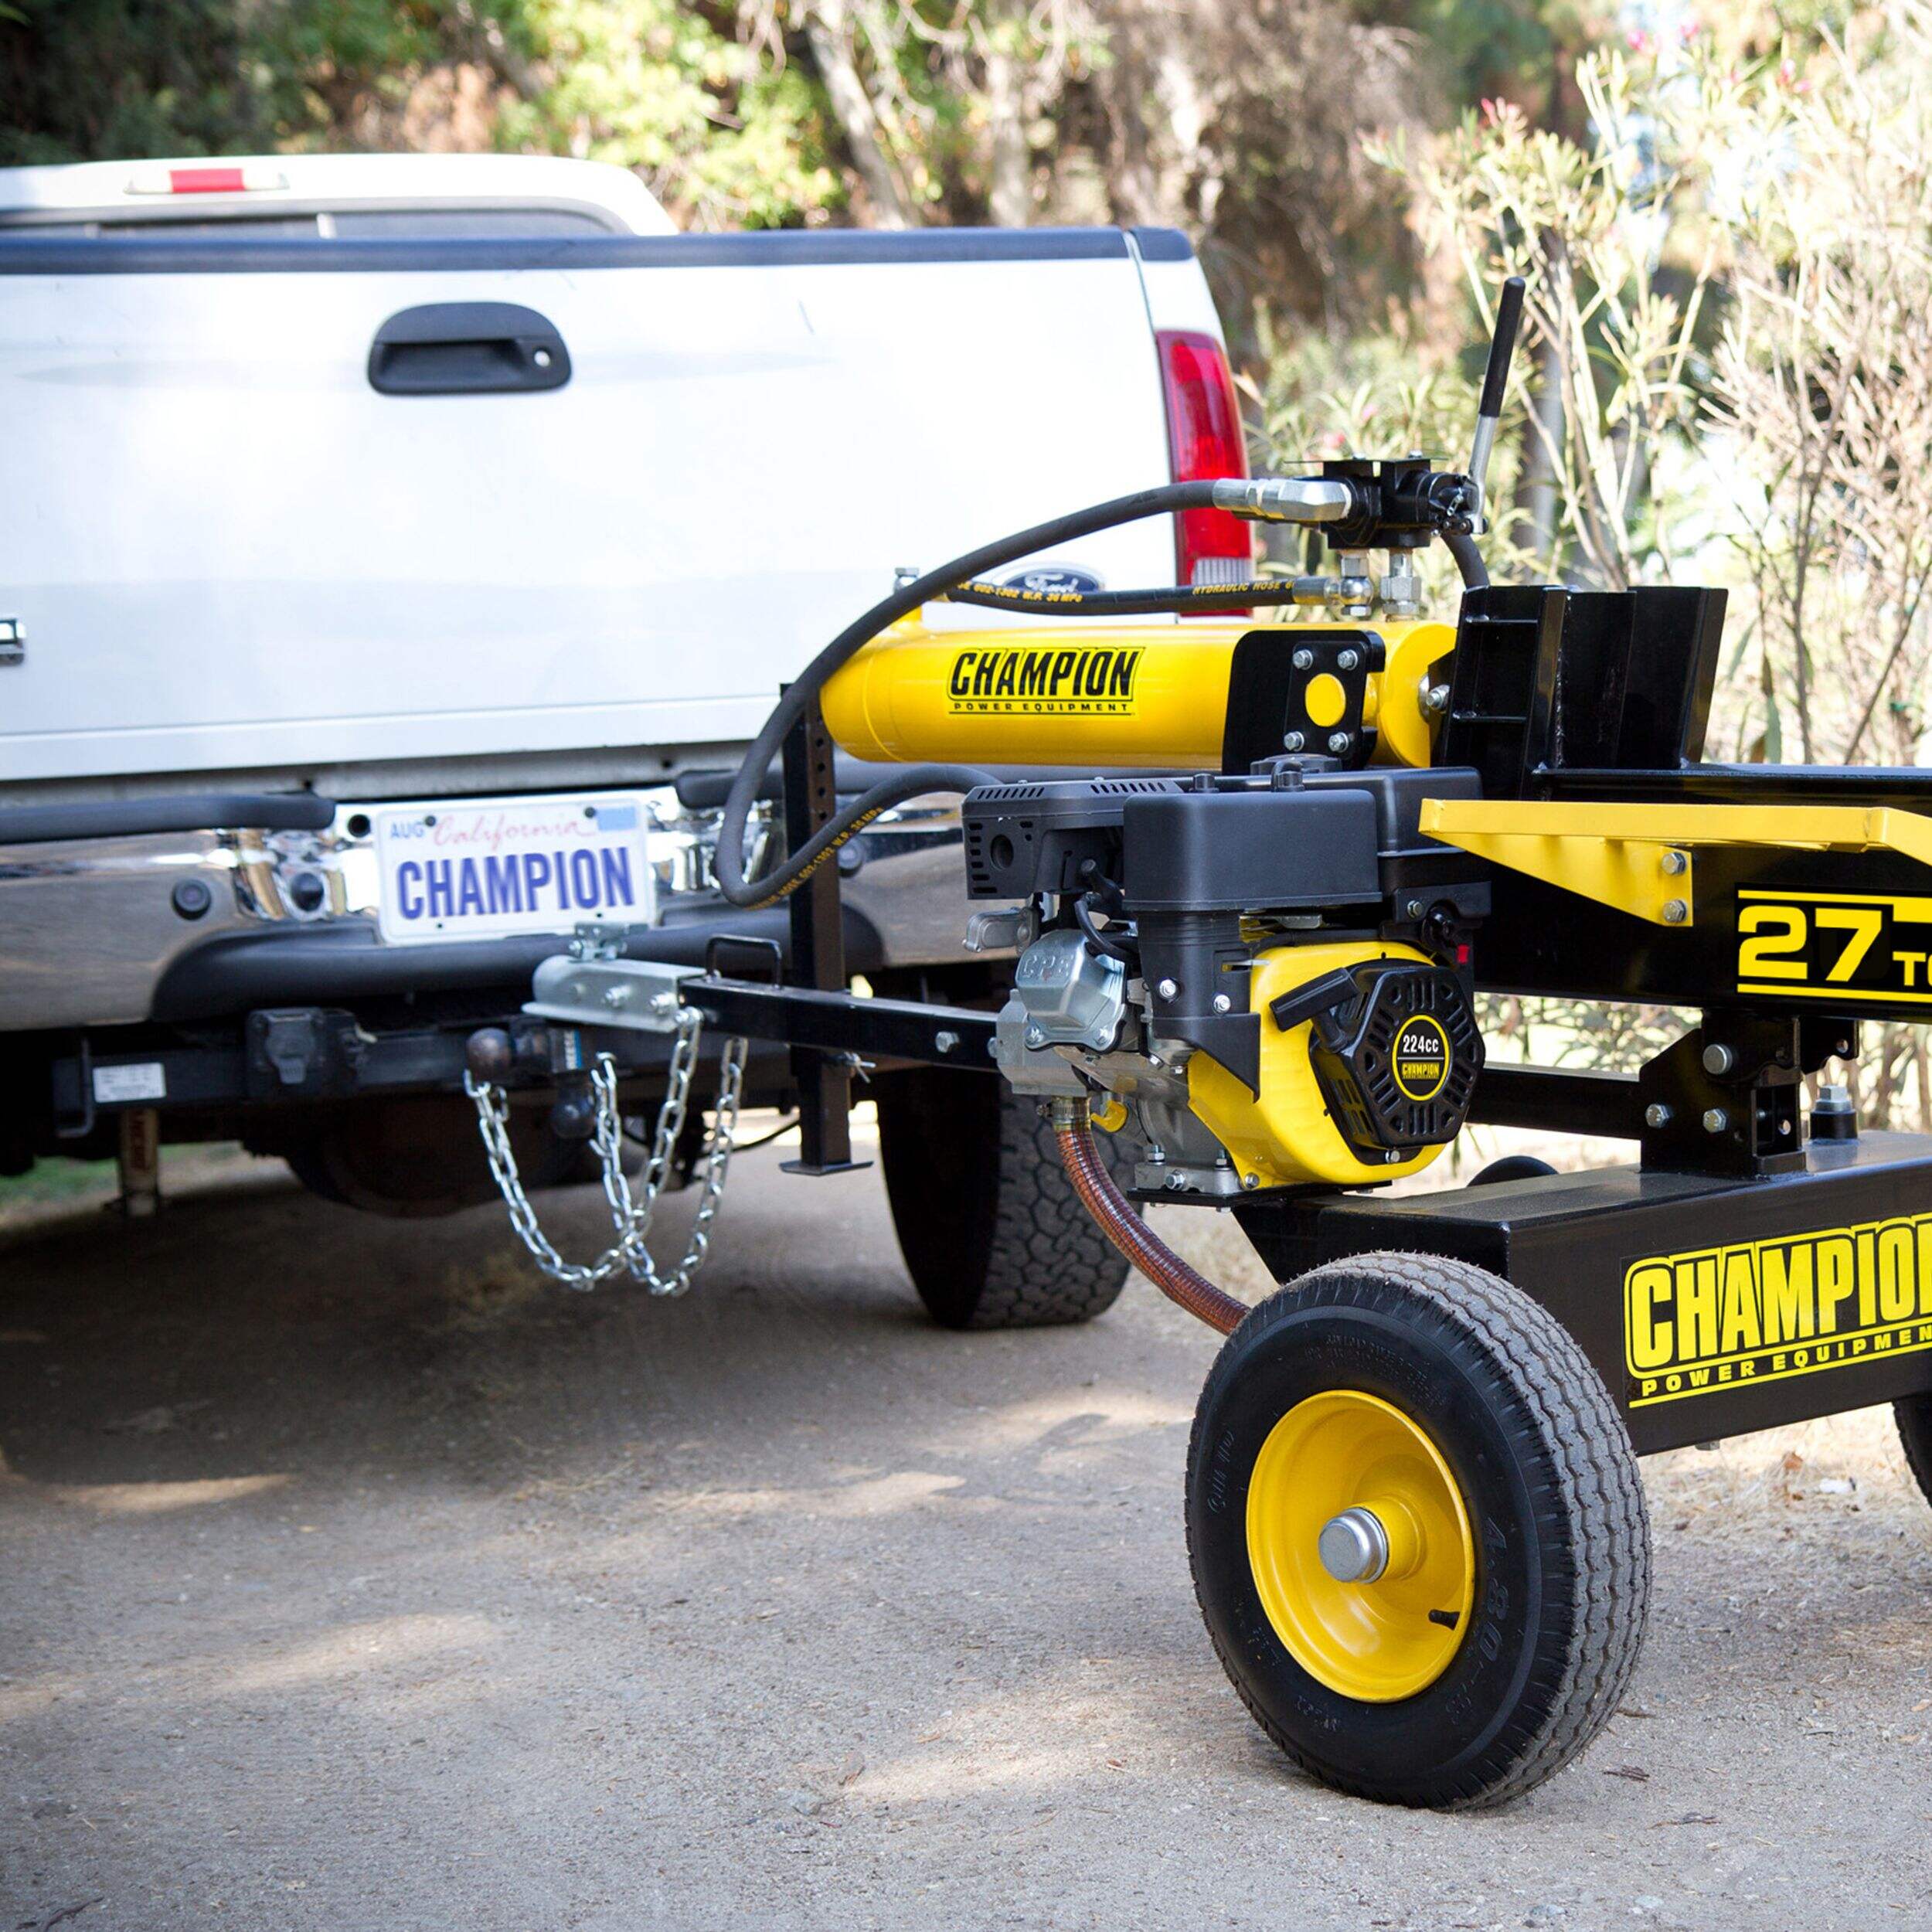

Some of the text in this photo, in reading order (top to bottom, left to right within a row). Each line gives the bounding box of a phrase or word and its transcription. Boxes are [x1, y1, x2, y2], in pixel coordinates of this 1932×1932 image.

[1025, 573, 1078, 592] Ford
[1192, 582, 1248, 595] HYDRAULIC
[1253, 581, 1280, 590] HOSE
[951, 651, 1138, 696] CHAMPION
[1023, 702, 1127, 713] EQUIPMENT
[390, 821, 423, 839] AUG
[432, 814, 597, 849] California
[397, 847, 634, 920] CHAMPION
[1738, 905, 1882, 981] 27
[1403, 1035, 1439, 1053] 224cc
[1642, 1361, 1755, 1396] POWER
